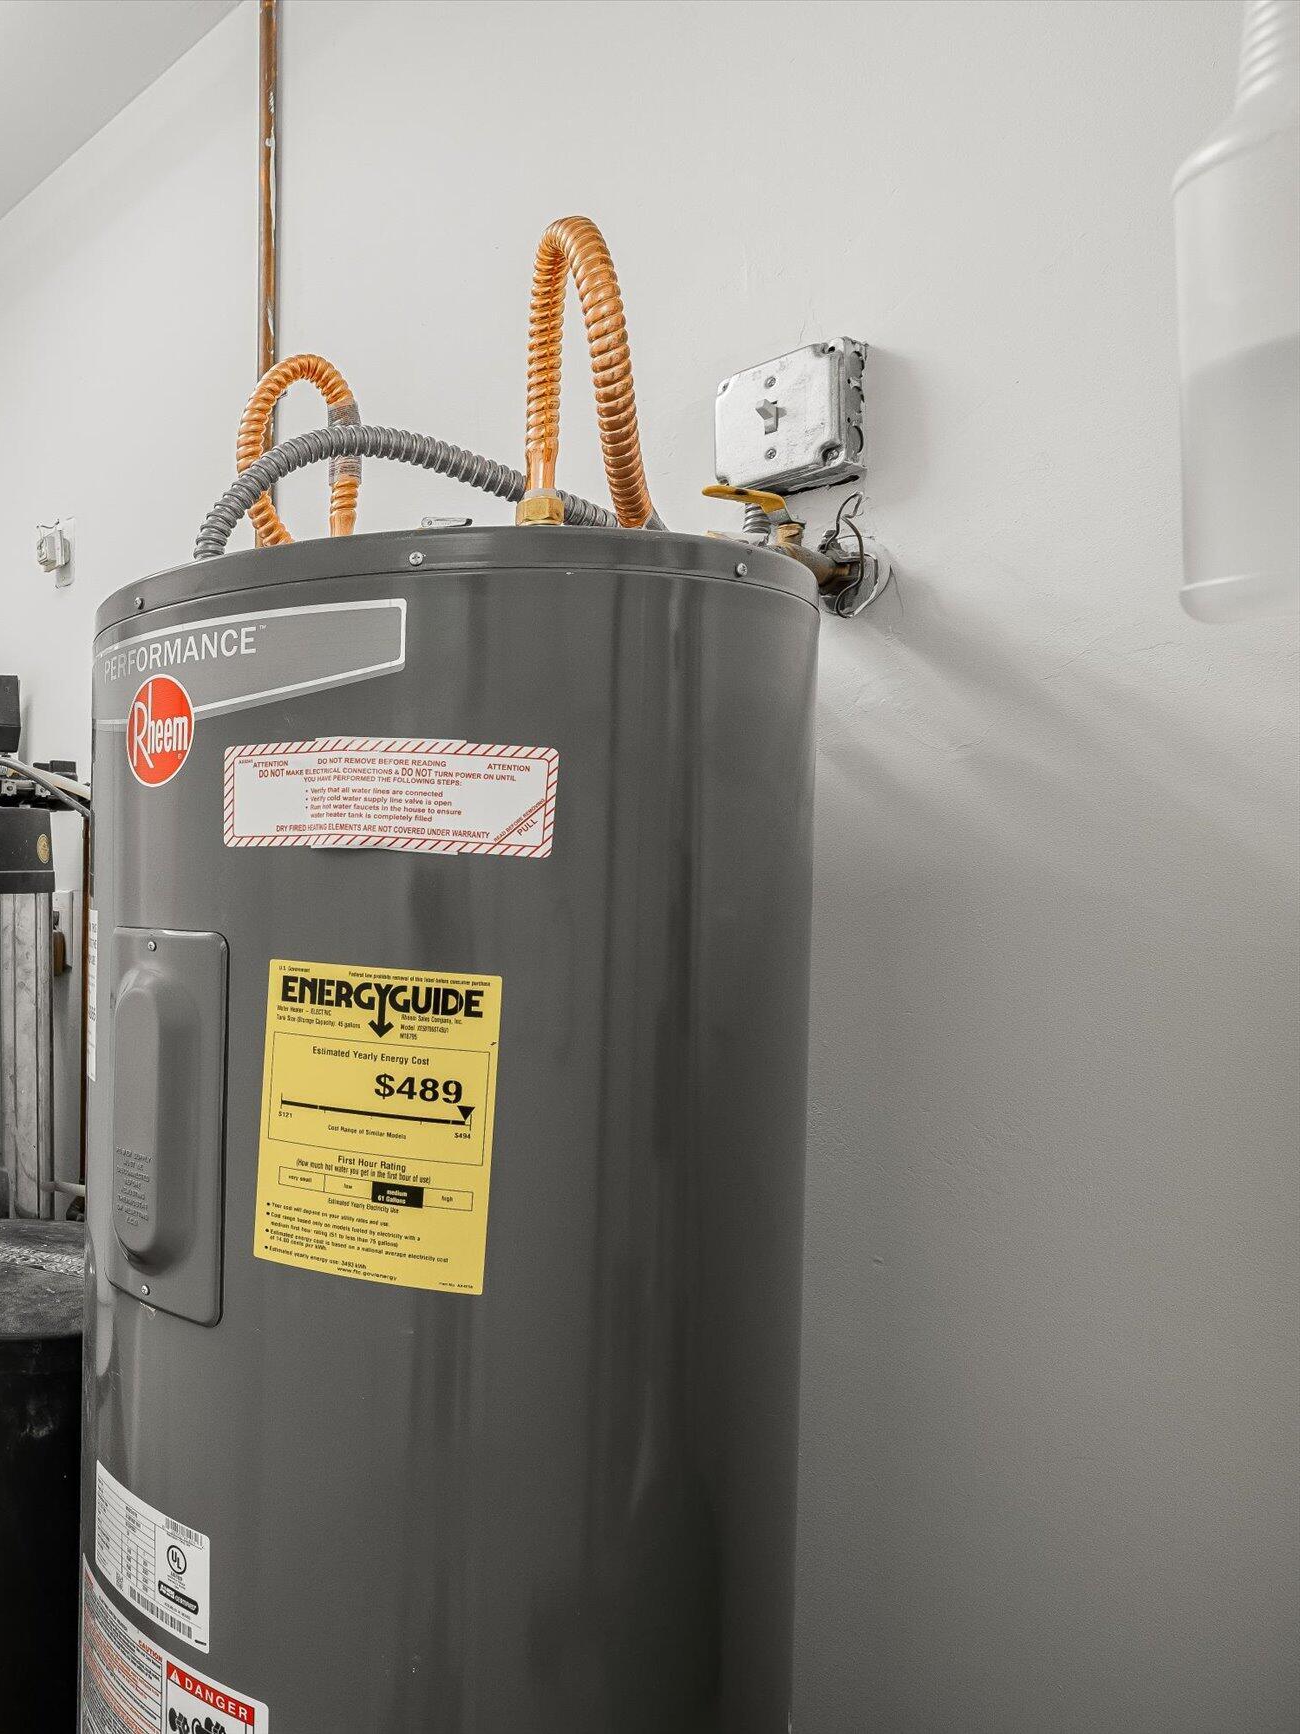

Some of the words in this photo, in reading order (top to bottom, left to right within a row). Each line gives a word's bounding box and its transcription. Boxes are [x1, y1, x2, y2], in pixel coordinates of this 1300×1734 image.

[133, 681, 189, 769] Rheem
[253, 760, 289, 768] ATTENTION
[378, 758, 409, 766] BEFORE
[412, 760, 446, 768] READING
[487, 764, 531, 772] ATTENTION
[258, 770, 268, 778] DO
[270, 768, 284, 778] NOT
[401, 768, 414, 776] DO
[414, 768, 432, 778] NOT
[455, 772, 482, 780] POWER
[496, 774, 516, 782] UNTIL
[392, 777, 435, 785] FOLLOWING
[374, 813, 412, 822] completely
[403, 806, 426, 814] house
[436, 808, 462, 816] ensure
[288, 824, 306, 832] FIRED
[328, 824, 361, 832] ELEMENTS
[394, 826, 426, 835] COVERED
[427, 828, 450, 836] UNDER
[452, 830, 490, 839] WARRANTY
[505, 816, 524, 832] BEFORE
[516, 818, 538, 836] PULL
[310, 1008, 332, 1016] ELECTRIC
[344, 1022, 360, 1030] gallons
[400, 1024, 416, 1032] Model
[312, 1046, 350, 1058] Estimated
[353, 1050, 378, 1062] Yearly
[380, 1053, 409, 1066] Energy
[412, 1056, 430, 1066] Cost
[374, 1073, 463, 1104] $489
[278, 1110, 293, 1119] $121
[328, 1124, 340, 1132] Cost
[340, 1125, 358, 1135] Range
[366, 1128, 386, 1138] Similar
[386, 1130, 406, 1140] Models
[454, 1132, 471, 1140] $494
[296, 1158, 308, 1167] (How
[310, 1160, 324, 1169] much
[324, 1162, 332, 1171] hot
[334, 1165, 348, 1174] water
[350, 1168, 359, 1178] you
[360, 1168, 369, 1178] get
[376, 1171, 385, 1179] the
[387, 1172, 398, 1180] first
[398, 1172, 412, 1182] hour
[412, 1174, 418, 1182] of
[420, 1176, 431, 1184] use)
[338, 1155, 356, 1166] First
[358, 1158, 377, 1168] Hour
[380, 1161, 406, 1174] Rating
[377, 1194, 384, 1202] 61
[386, 1195, 406, 1204] Gallons
[386, 1189, 408, 1197] medium
[328, 1197, 350, 1207] Estimated
[350, 1201, 365, 1210] Yearly
[366, 1204, 390, 1214] Electricity
[270, 1221, 290, 1229] medium
[314, 1230, 328, 1238] rating
[282, 1214, 296, 1222] range
[297, 1216, 312, 1224] based
[312, 1220, 322, 1228] only
[332, 1223, 350, 1232] models
[352, 1226, 368, 1234] fueled
[376, 1230, 403, 1240] electricity
[369, 1218, 378, 1226] and
[270, 1228, 294, 1238] Estimated
[294, 1234, 312, 1243] energy
[331, 1240, 347, 1248] based
[362, 1246, 384, 1254] national
[384, 1250, 406, 1258] average
[408, 1252, 436, 1262] electricity
[269, 1246, 292, 1256] Estimated
[294, 1252, 310, 1260] yearly
[310, 1256, 328, 1264] energy
[171, 1549, 182, 1570] UL
[138, 1640, 162, 1662] CAUTION
[185, 1682, 248, 1721] DANGER
